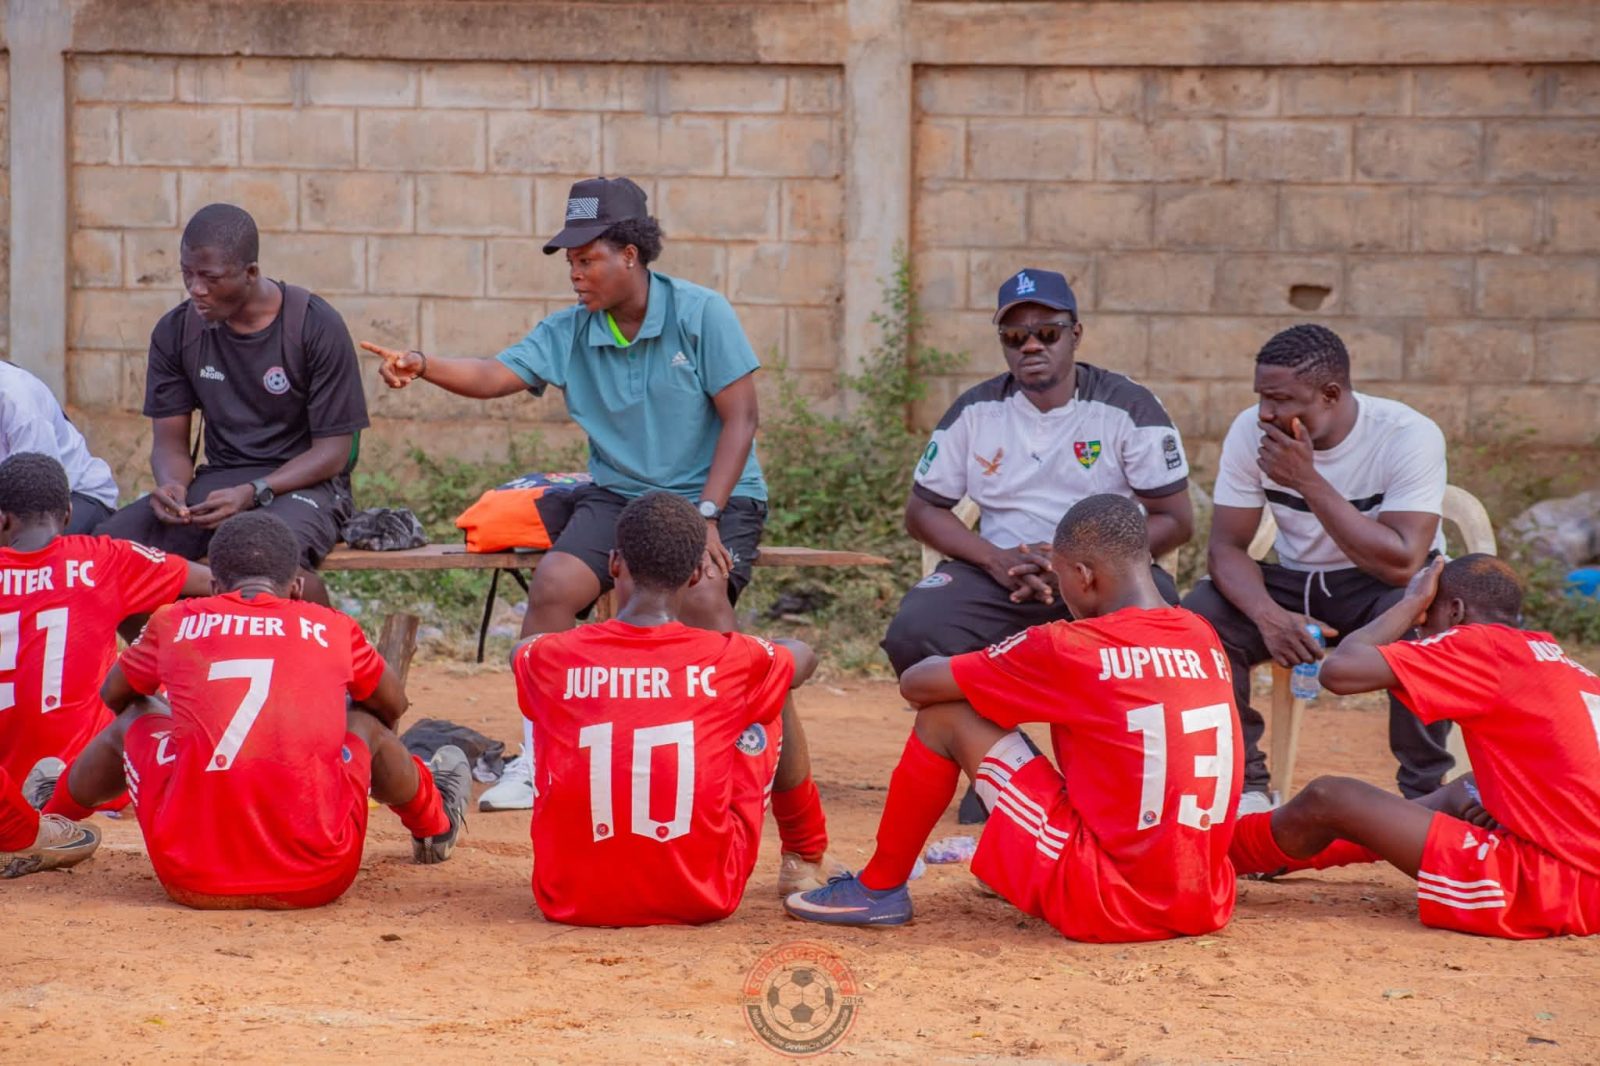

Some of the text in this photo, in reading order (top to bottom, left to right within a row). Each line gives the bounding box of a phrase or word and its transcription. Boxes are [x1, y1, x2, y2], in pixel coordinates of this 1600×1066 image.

[0, 560, 95, 595] ITER FC
[173, 613, 329, 648] JUPITER FC
[563, 665, 717, 700] JUPITER FC
[1098, 646, 1231, 683] JUPITER F
[205, 658, 275, 772] 7
[578, 720, 696, 843] 10
[1126, 703, 1234, 831] 13
